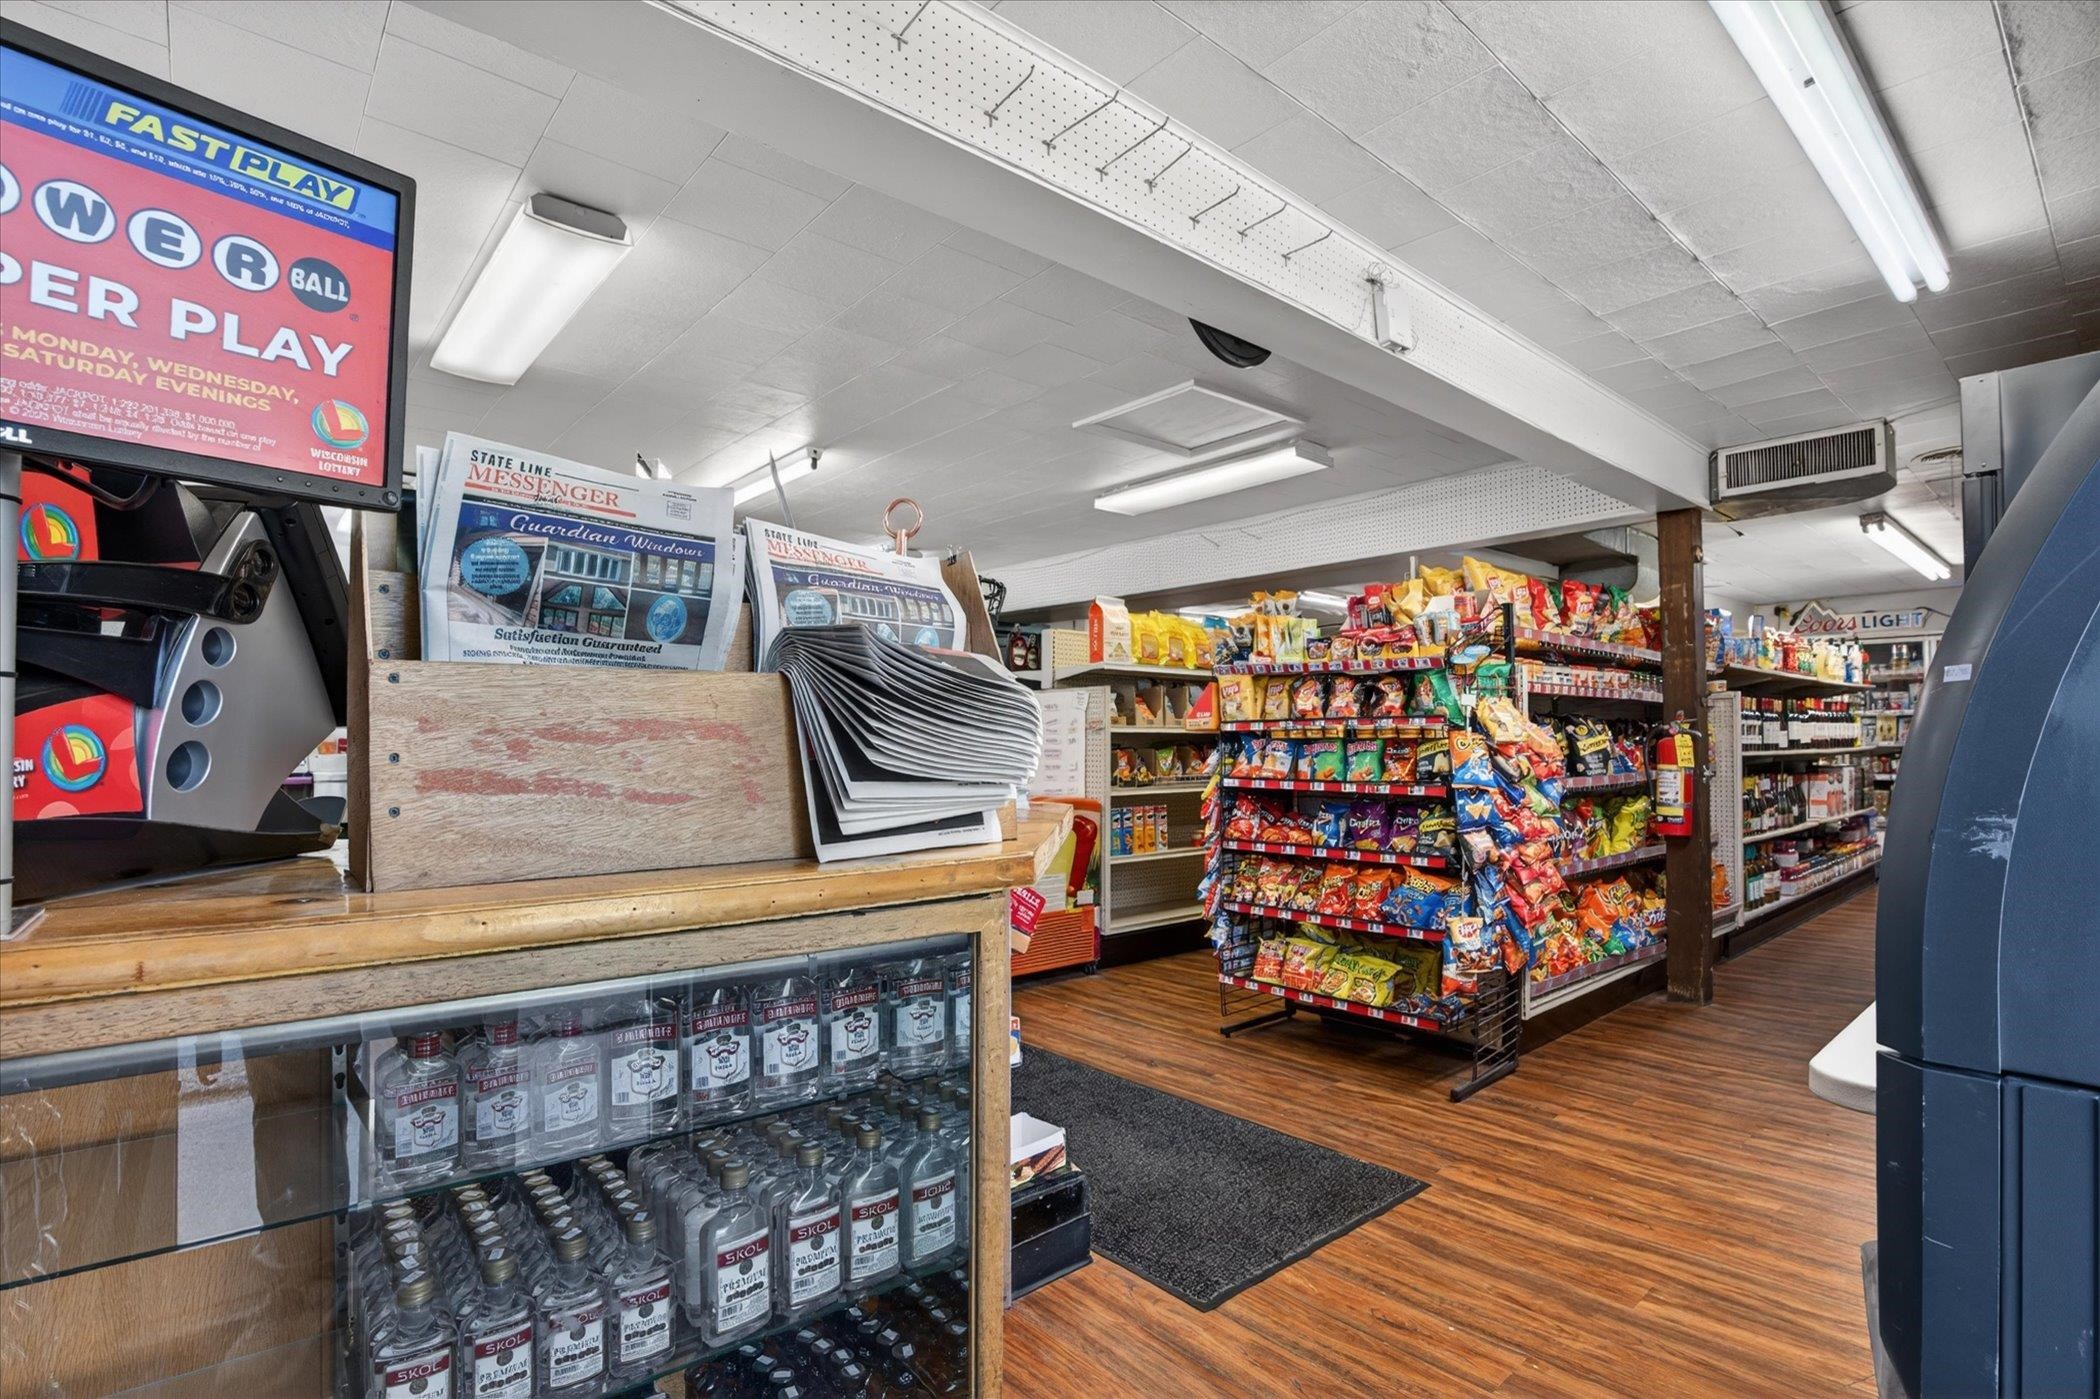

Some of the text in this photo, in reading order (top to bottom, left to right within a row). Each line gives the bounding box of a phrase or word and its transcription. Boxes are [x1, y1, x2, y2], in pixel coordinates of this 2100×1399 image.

[105, 102, 348, 203] FAST PLAY
[290, 265, 349, 303] BALL
[169, 297, 354, 378] PLAY
[2, 342, 149, 387] SATURDAY
[155, 377, 273, 411] EVENINGS
[12, 325, 141, 370] MONDAY,
[147, 356, 300, 405] WEDNESDAY,
[310, 447, 369, 467] WISCONSIN
[470, 449, 553, 477] STATE LINE
[467, 462, 620, 508] MESSENGER
[509, 513, 619, 546] Guardian
[624, 533, 706, 558] Windows
[765, 528, 793, 544] STATE
[1793, 612, 1923, 635] Coors LIGHT
[494, 627, 580, 648] Satisfaction
[582, 636, 664, 655] Guaranteed
[858, 1201, 895, 1219] SKOL
[797, 1219, 836, 1240] SKOL
[725, 1242, 763, 1265] SKOL
[485, 1334, 526, 1355] SKOL
[397, 1364, 442, 1383] SKOL
